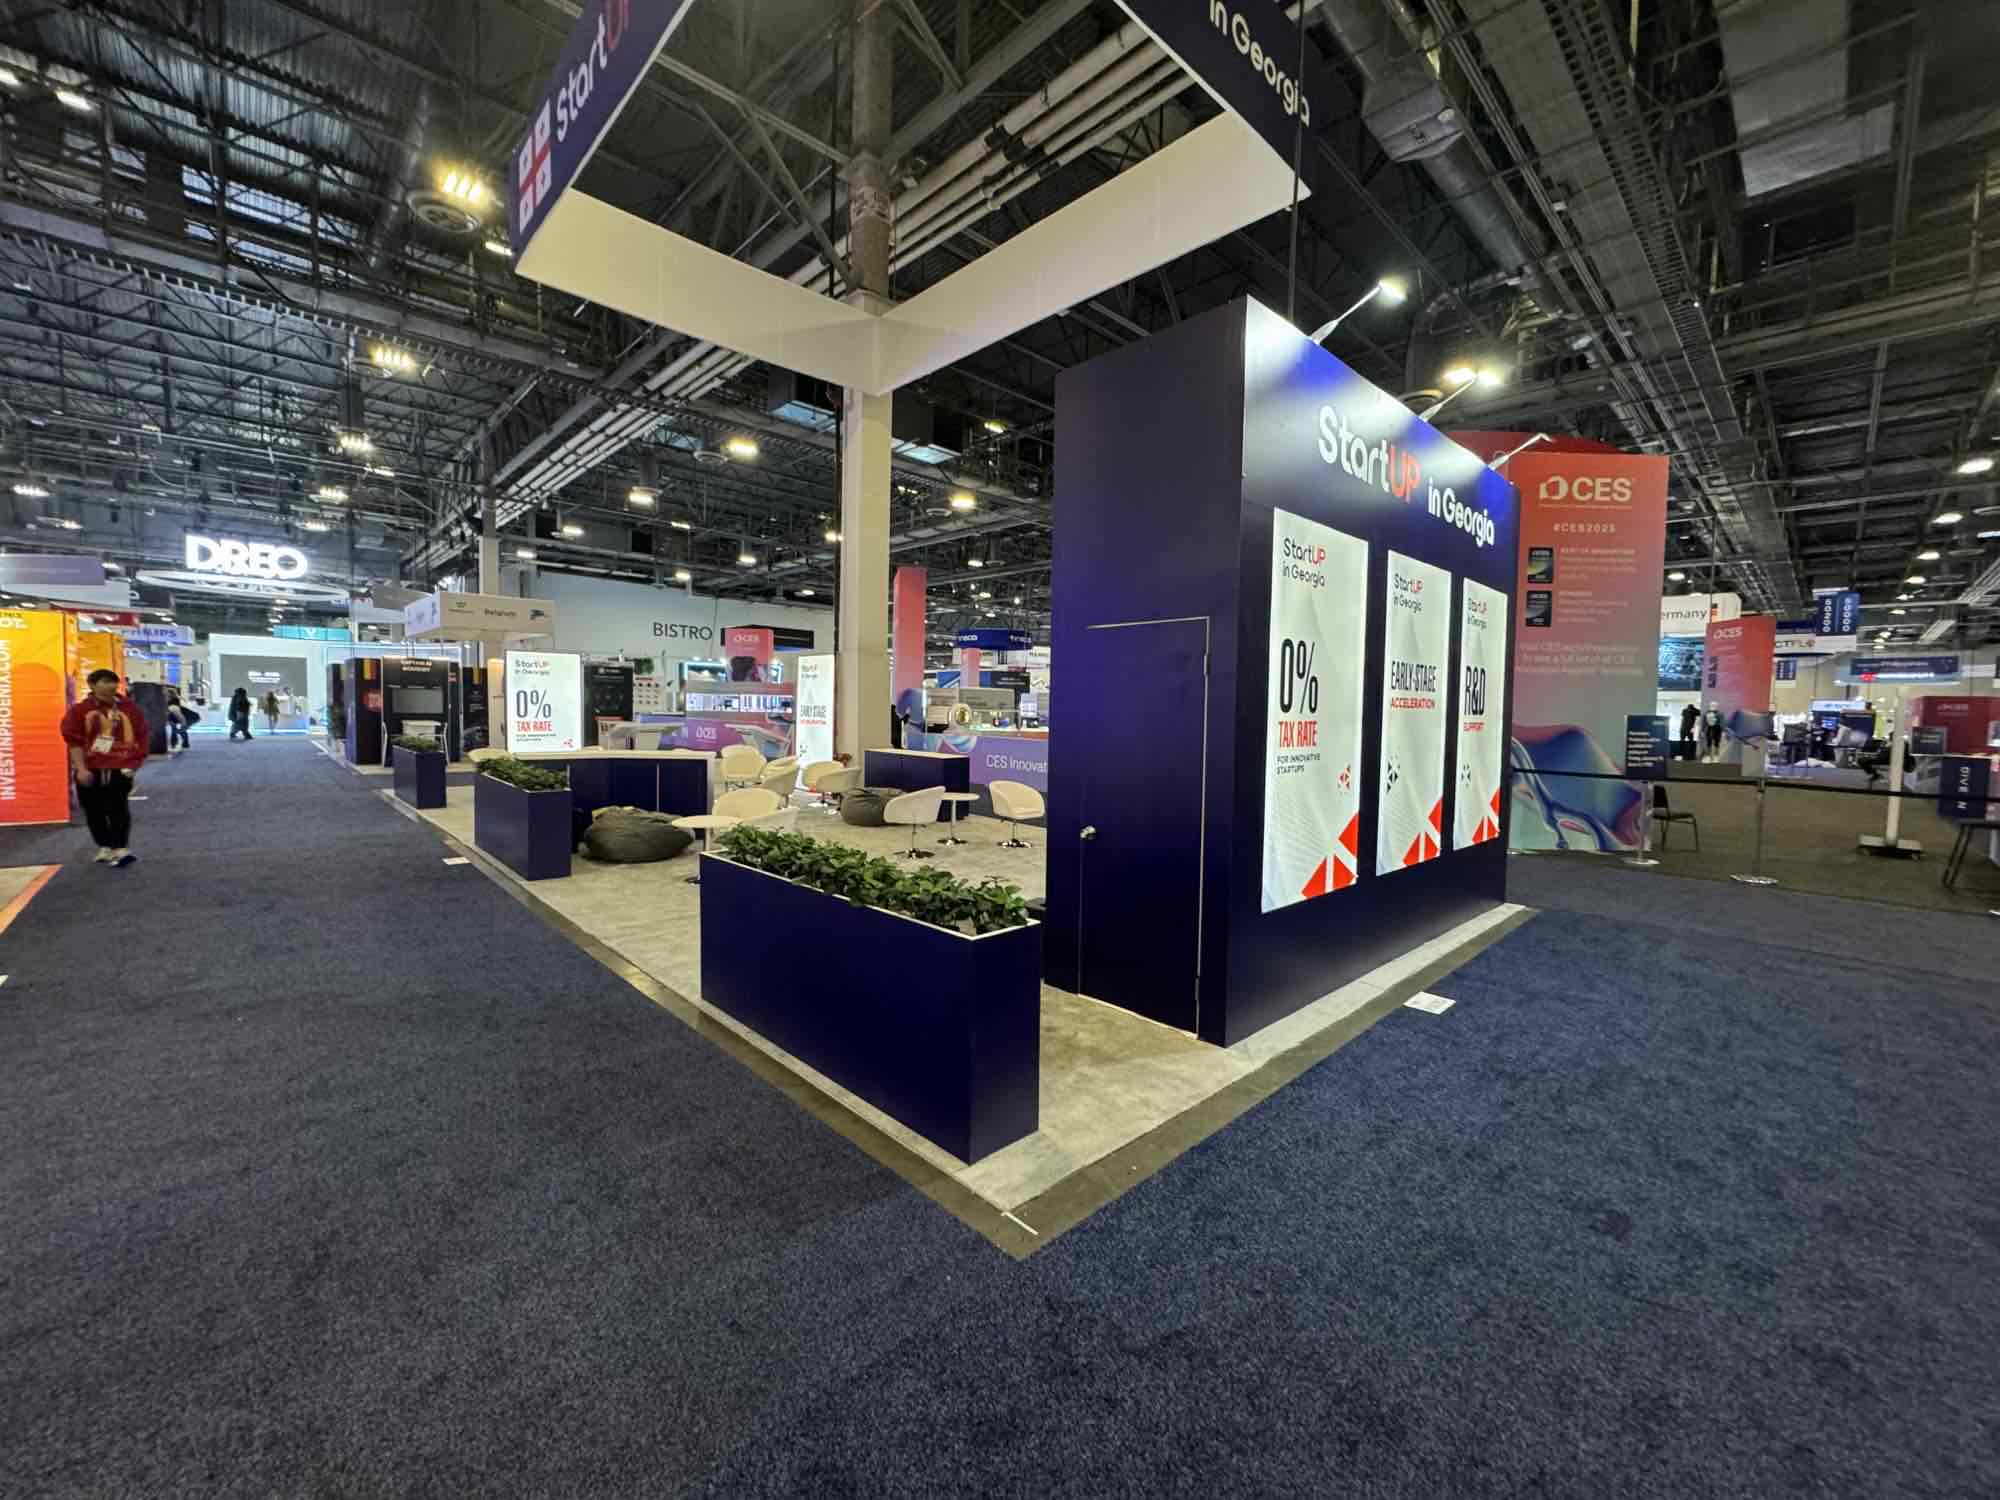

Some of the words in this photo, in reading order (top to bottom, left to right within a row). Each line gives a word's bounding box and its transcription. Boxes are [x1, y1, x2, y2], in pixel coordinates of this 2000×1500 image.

[1232, 13, 1310, 128] Georgia
[1318, 405, 1421, 504] StartUP
[1427, 476, 1440, 518] in
[1442, 487, 1495, 548] Georgia
[1571, 477, 1632, 502] CES
[186, 534, 308, 579] DREO
[1283, 538, 1326, 566] StartUP
[1283, 562, 1289, 579] in
[1291, 567, 1326, 588] Georgia
[653, 622, 713, 641] BISTRO
[1279, 637, 1319, 715] 0%
[1464, 664, 1486, 716] R&D
[516, 689, 552, 719] 0%
[516, 720, 531, 732] TAX
[533, 720, 552, 732] RATE
[1279, 720, 1296, 748] TAX
[1296, 720, 1318, 748] RATE
[986, 754, 1009, 769] CES
